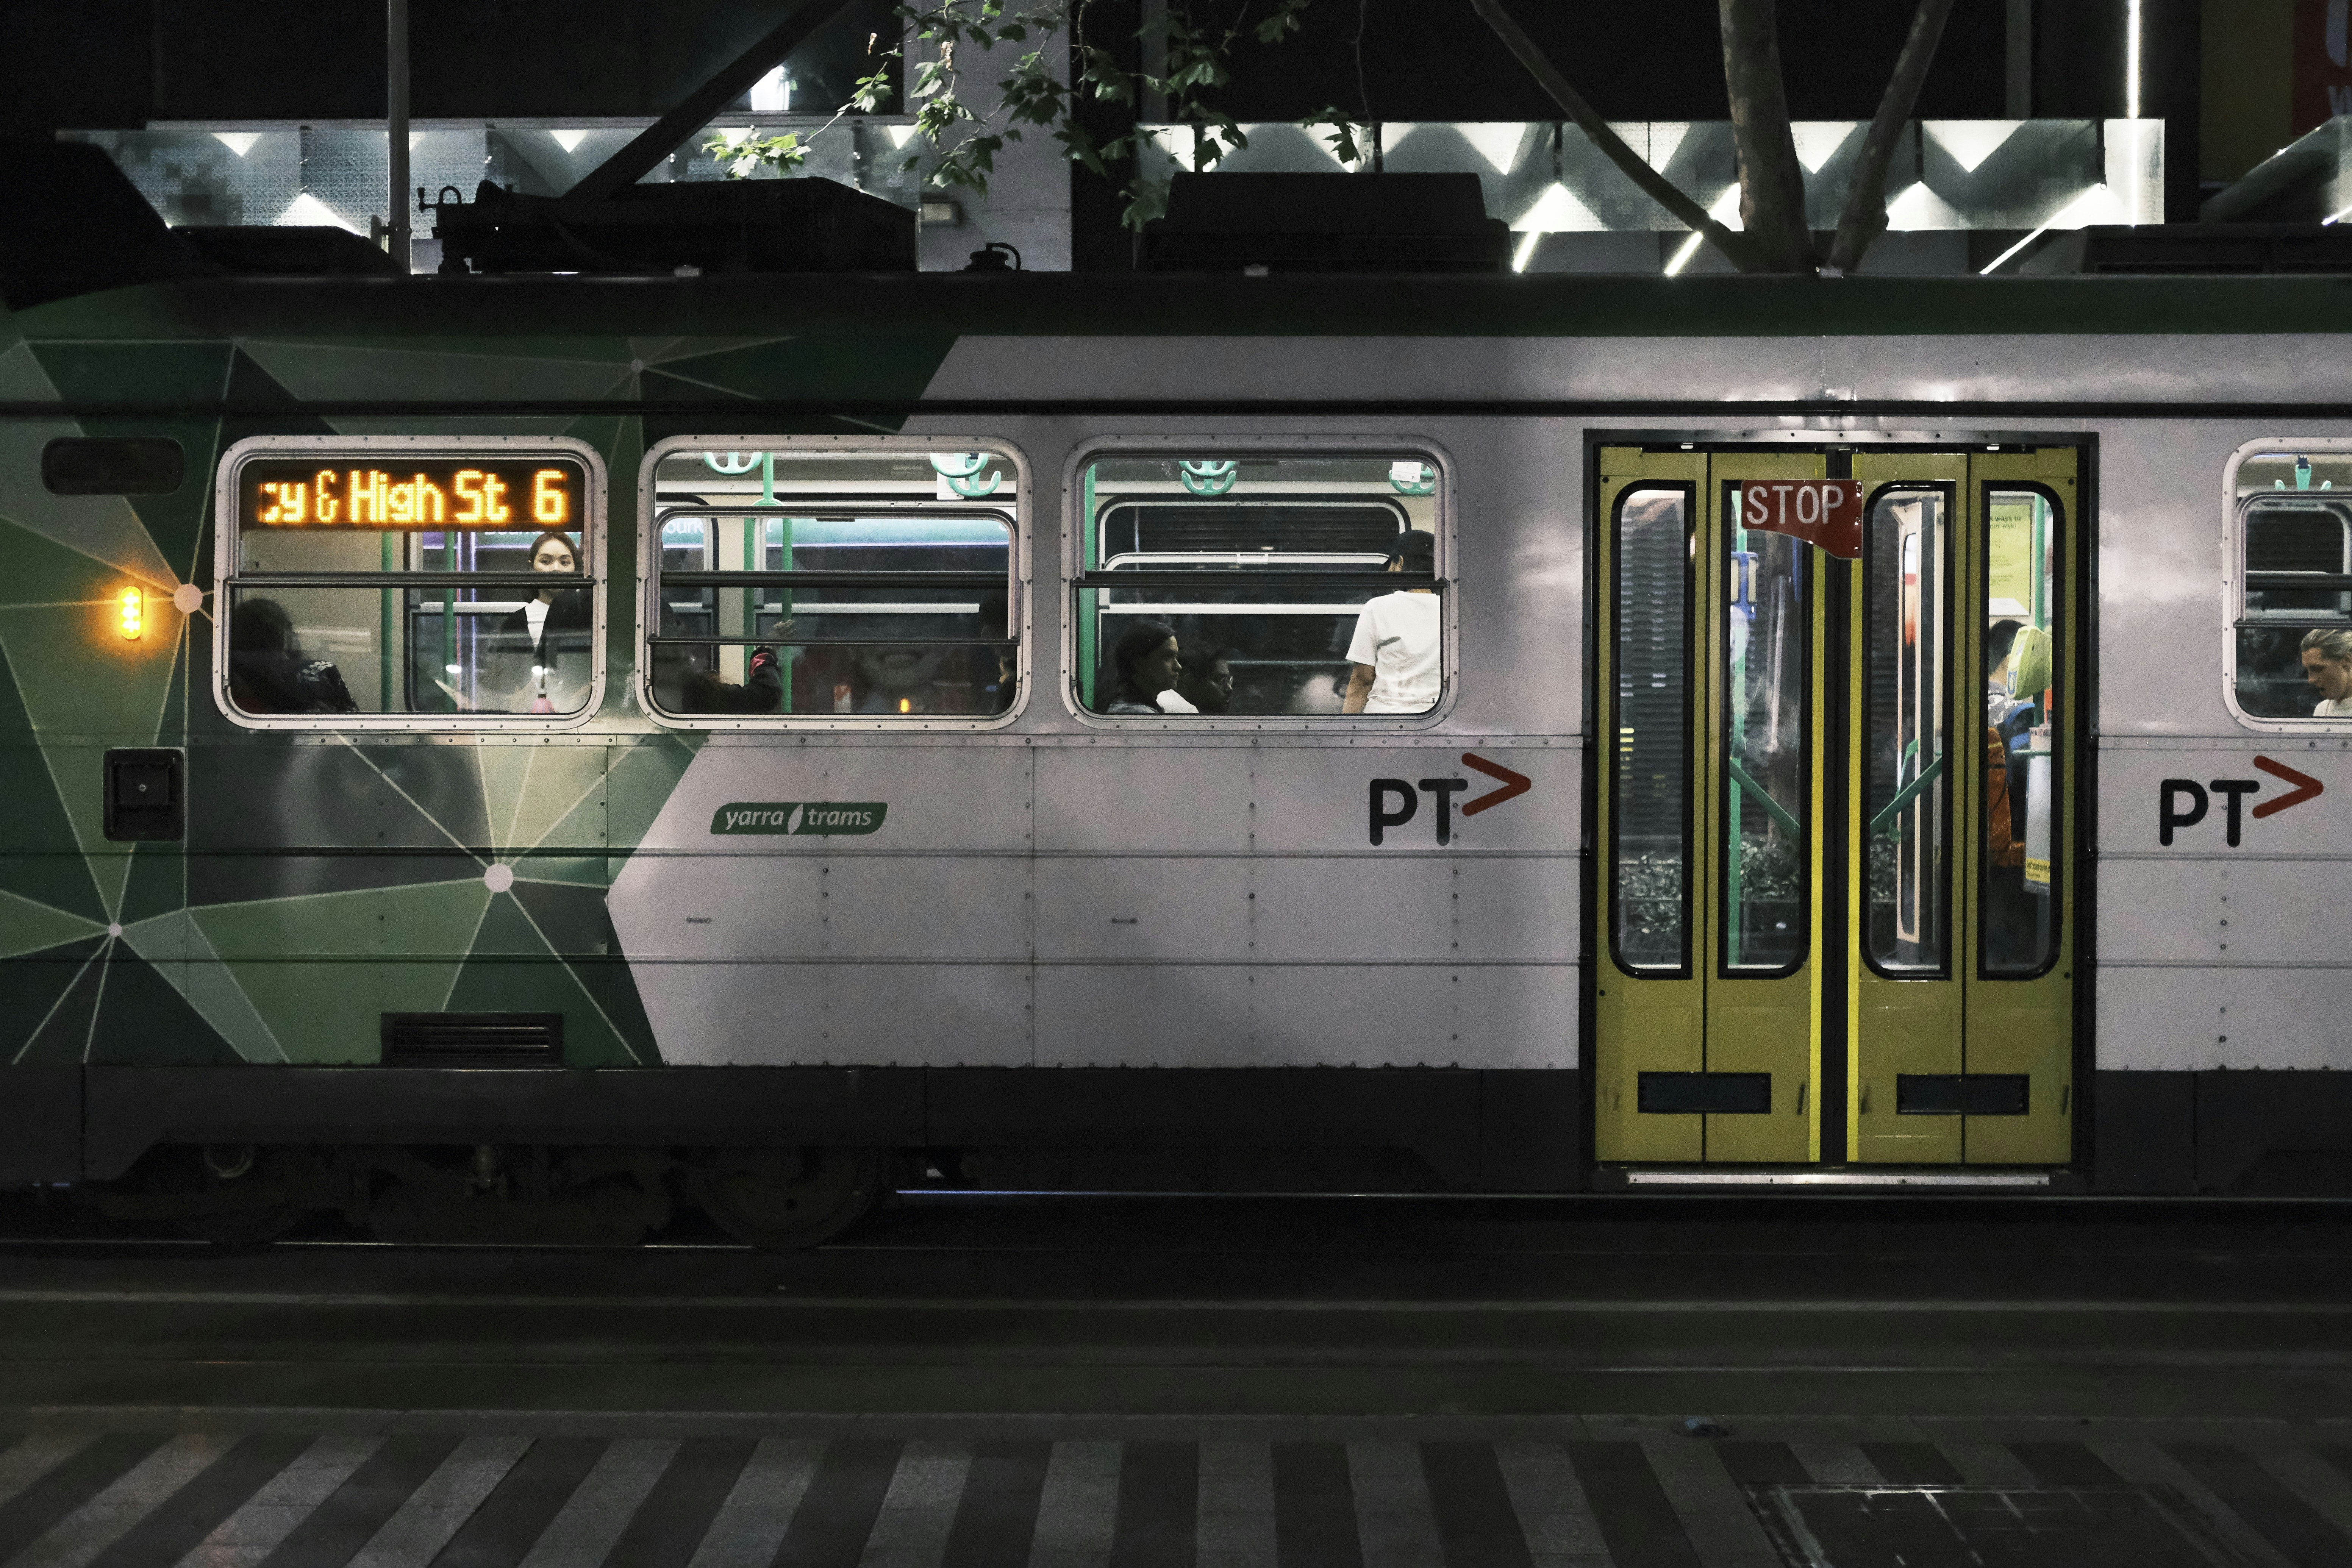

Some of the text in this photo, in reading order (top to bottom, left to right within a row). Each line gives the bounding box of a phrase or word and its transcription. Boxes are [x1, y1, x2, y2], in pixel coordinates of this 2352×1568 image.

[316, 470, 338, 523] &
[350, 470, 444, 523] High
[455, 470, 509, 523] St
[534, 470, 567, 523] 6
[1747, 485, 1844, 525] STOP
[726, 808, 872, 831] yarra trams
